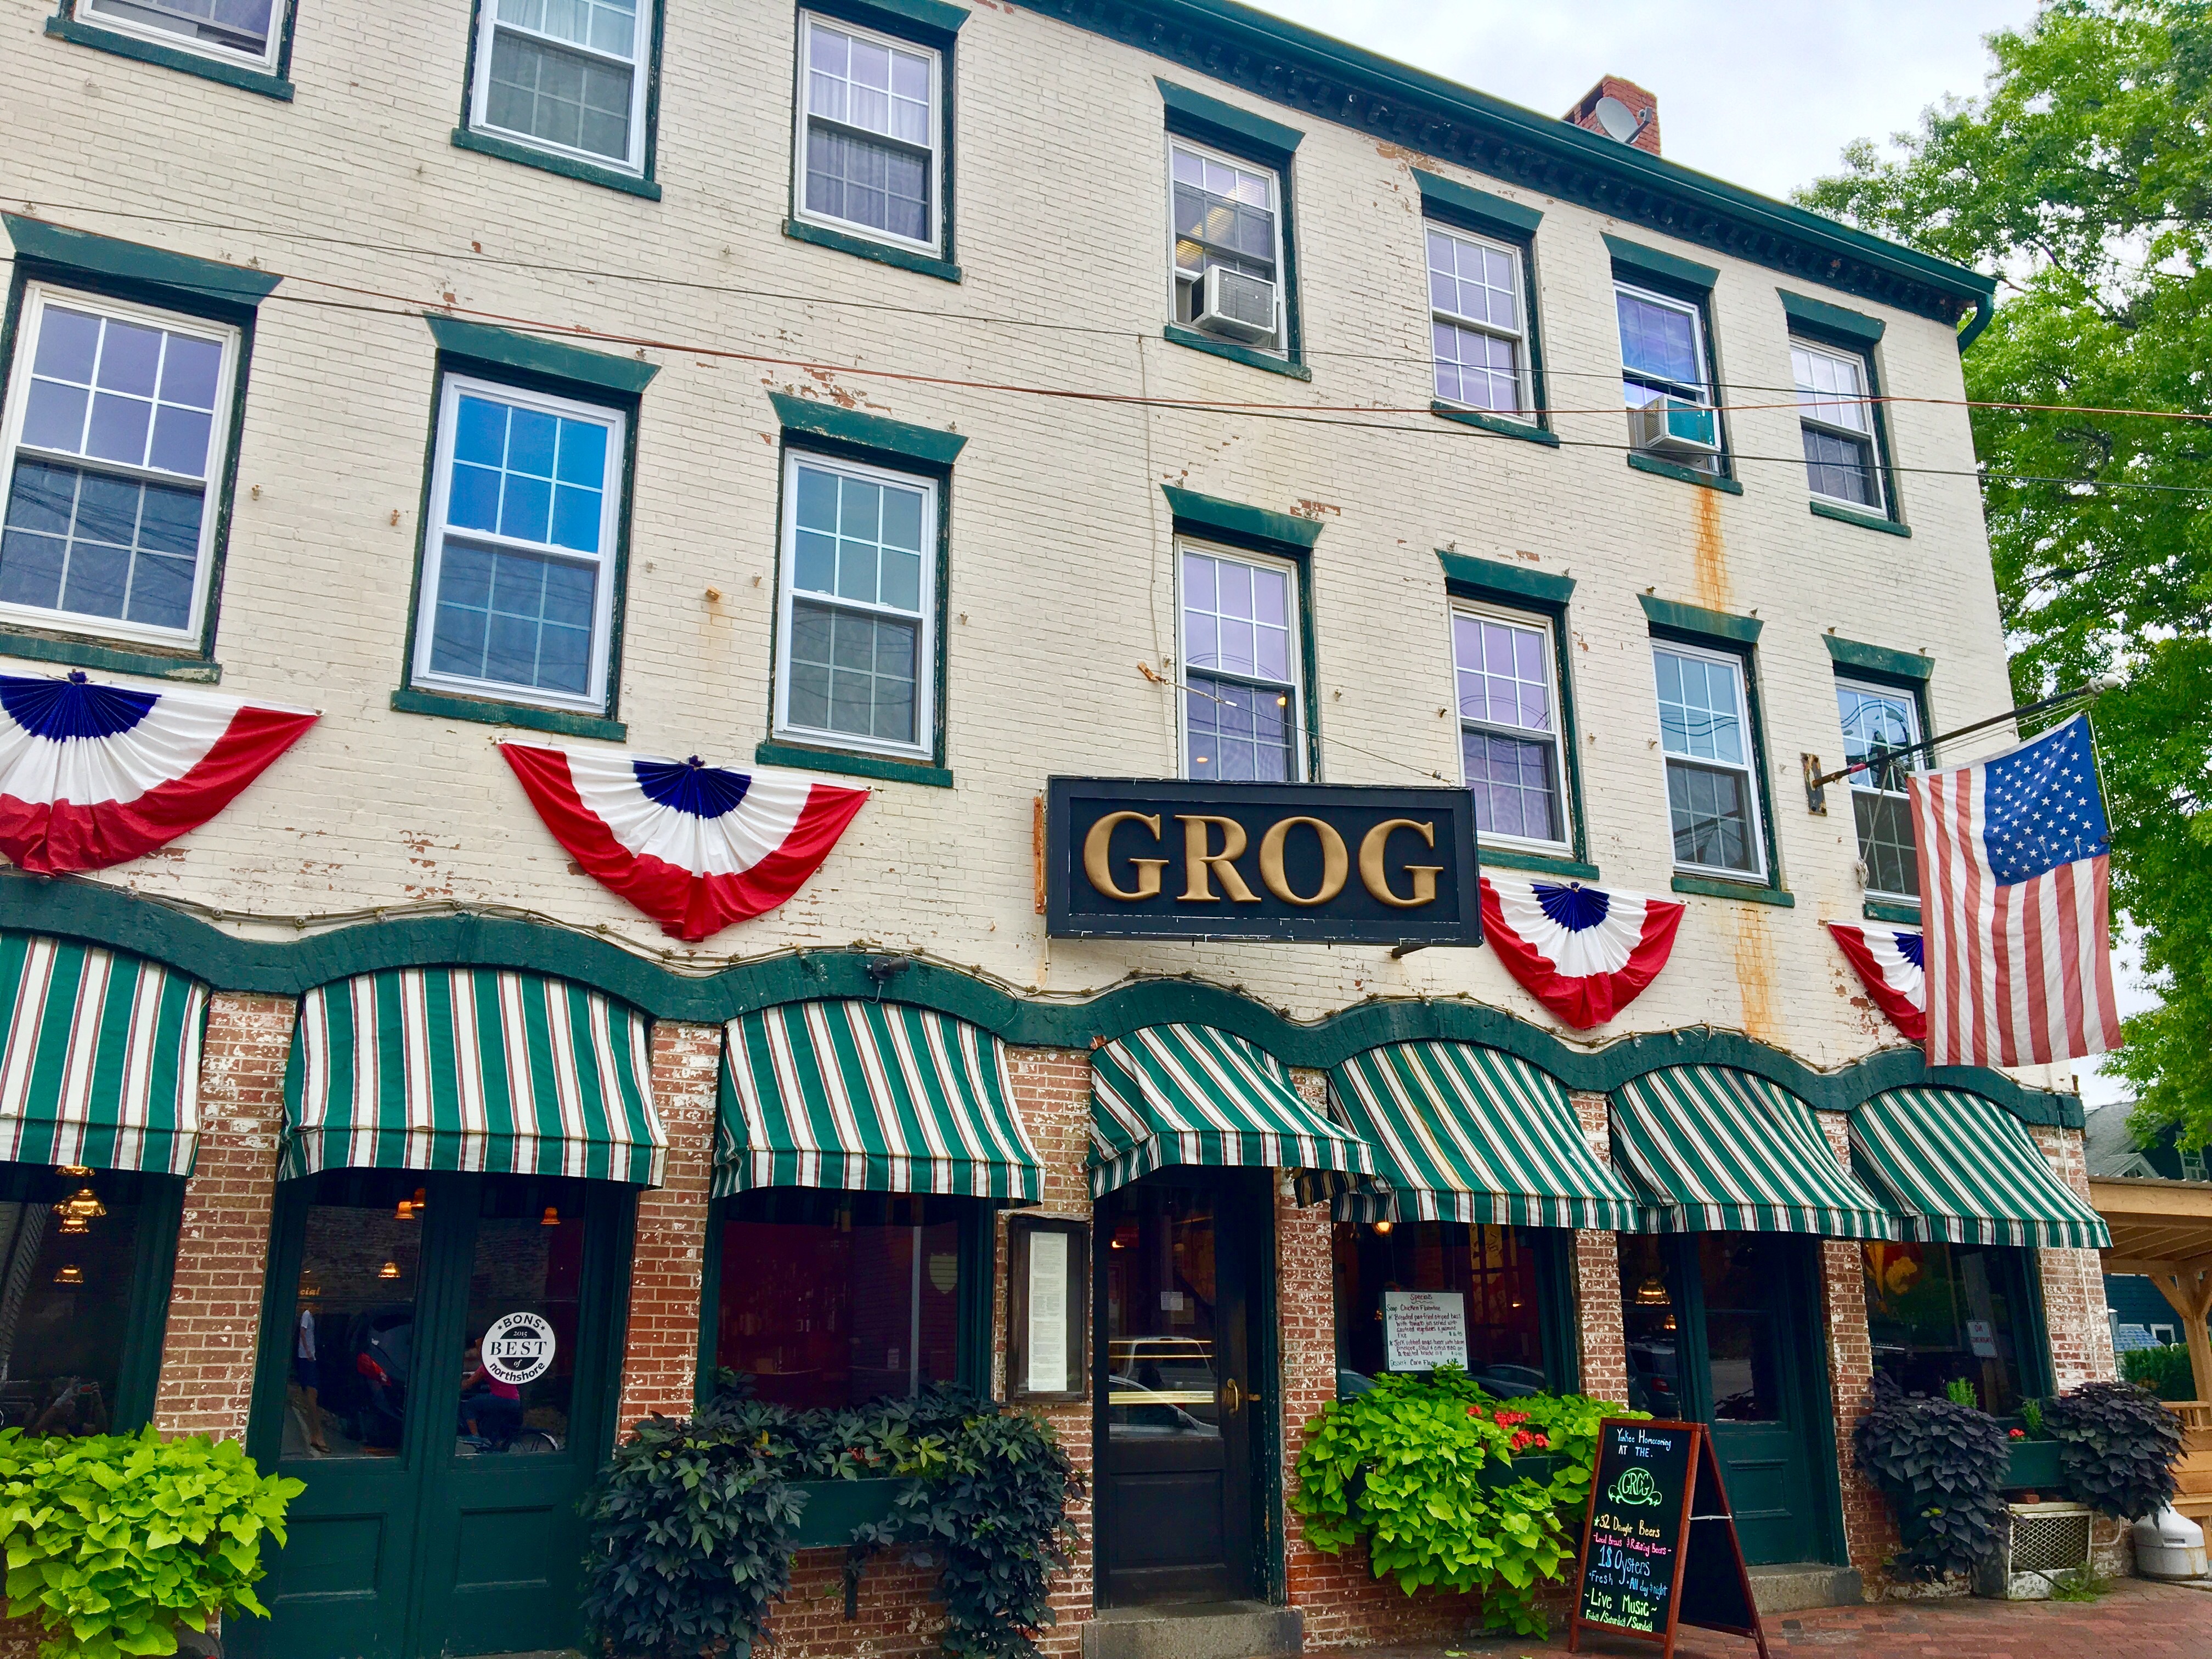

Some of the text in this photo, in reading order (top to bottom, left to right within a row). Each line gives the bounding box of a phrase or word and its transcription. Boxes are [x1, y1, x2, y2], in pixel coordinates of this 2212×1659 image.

[1083, 810, 1444, 909] GROG
[503, 1314, 542, 1328] BONS
[490, 1341, 547, 1355] BEST
[489, 1362, 545, 1381] northshore
[514, 1359, 522, 1368] of
[1617, 1428, 1672, 1452] Yankee Homecoming
[1618, 1444, 1628, 1455] AT
[1622, 1472, 1650, 1496] GROG
[1599, 1514, 1610, 1529] 32
[1639, 1519, 1660, 1538] Beers
[1608, 1534, 1622, 1547] Brews
[1630, 1538, 1650, 1557] Rotating
[1614, 1550, 1650, 1584] Oysters
[1640, 1579, 1649, 1597] day
[1653, 1583, 1668, 1600] night
